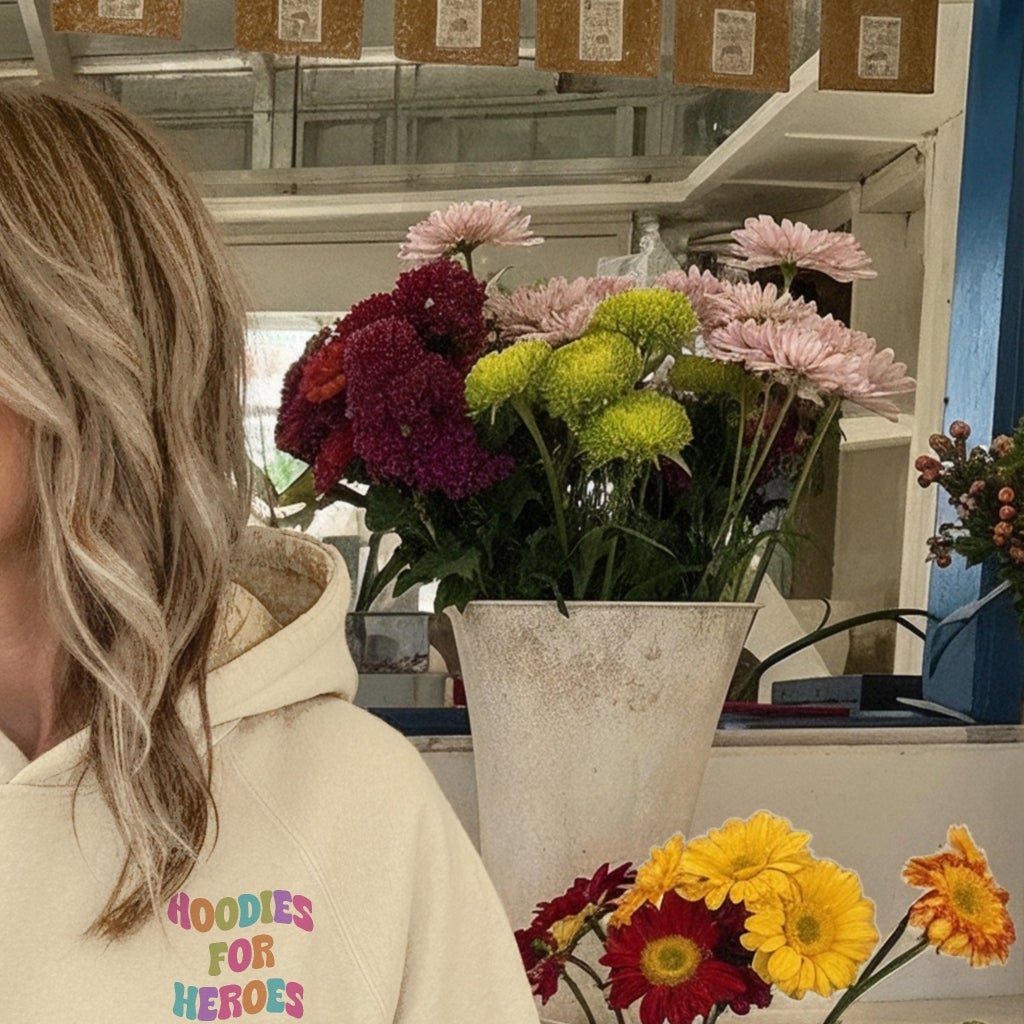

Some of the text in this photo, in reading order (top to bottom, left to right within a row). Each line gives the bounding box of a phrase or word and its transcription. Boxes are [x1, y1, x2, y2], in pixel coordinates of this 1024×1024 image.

[167, 889, 314, 932] HOODIES
[208, 934, 275, 976] FOR
[172, 977, 304, 1021] HEROES
